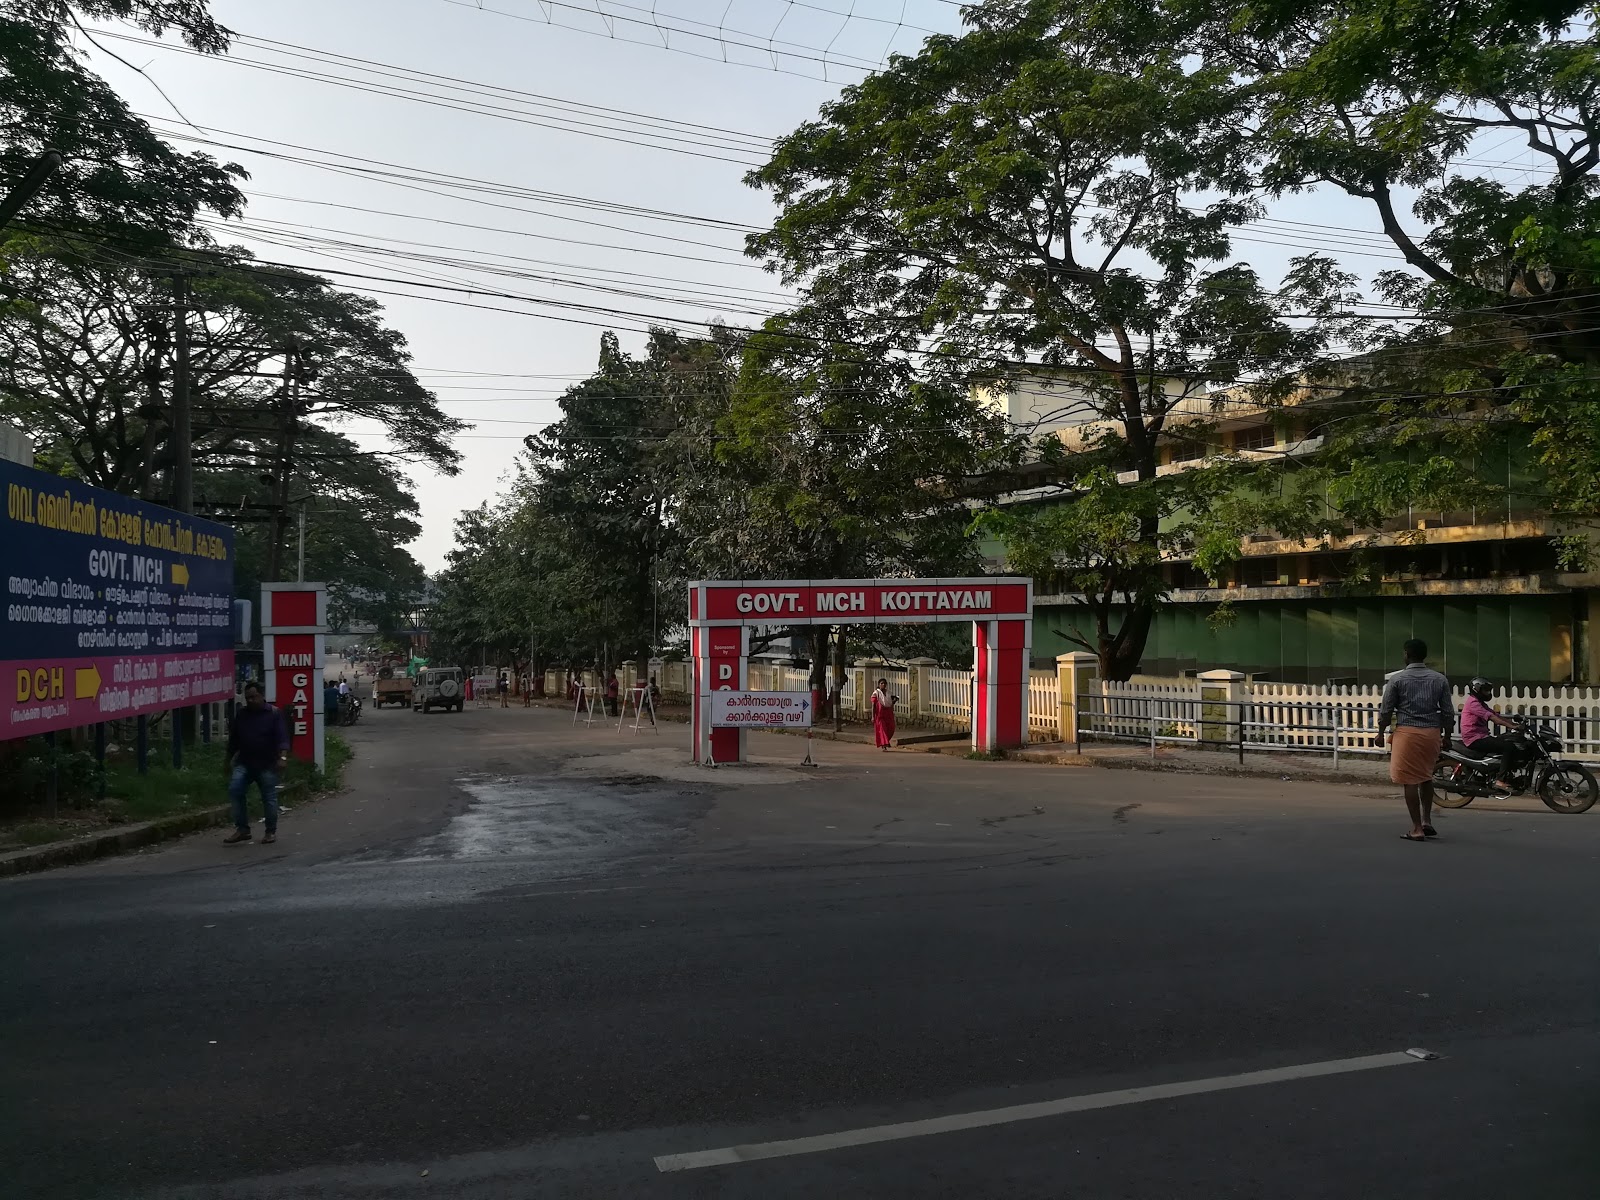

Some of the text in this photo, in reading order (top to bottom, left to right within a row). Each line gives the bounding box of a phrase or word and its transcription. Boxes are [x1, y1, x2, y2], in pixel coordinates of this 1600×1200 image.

[38, 490, 97, 535] മെഡിക്കൽ
[100, 507, 142, 545] കോളേജ്
[89, 549, 163, 585] GOVT. MCH
[9, 576, 58, 599] അത്യാഹിത
[61, 577, 94, 600] വിഭാഗം
[736, 590, 992, 613] GOVT. MCH KOTTAYAM
[279, 654, 312, 667] MAIN
[17, 667, 64, 702] DCH
[292, 673, 308, 735] GATE
[786, 711, 804, 722] വഴി
